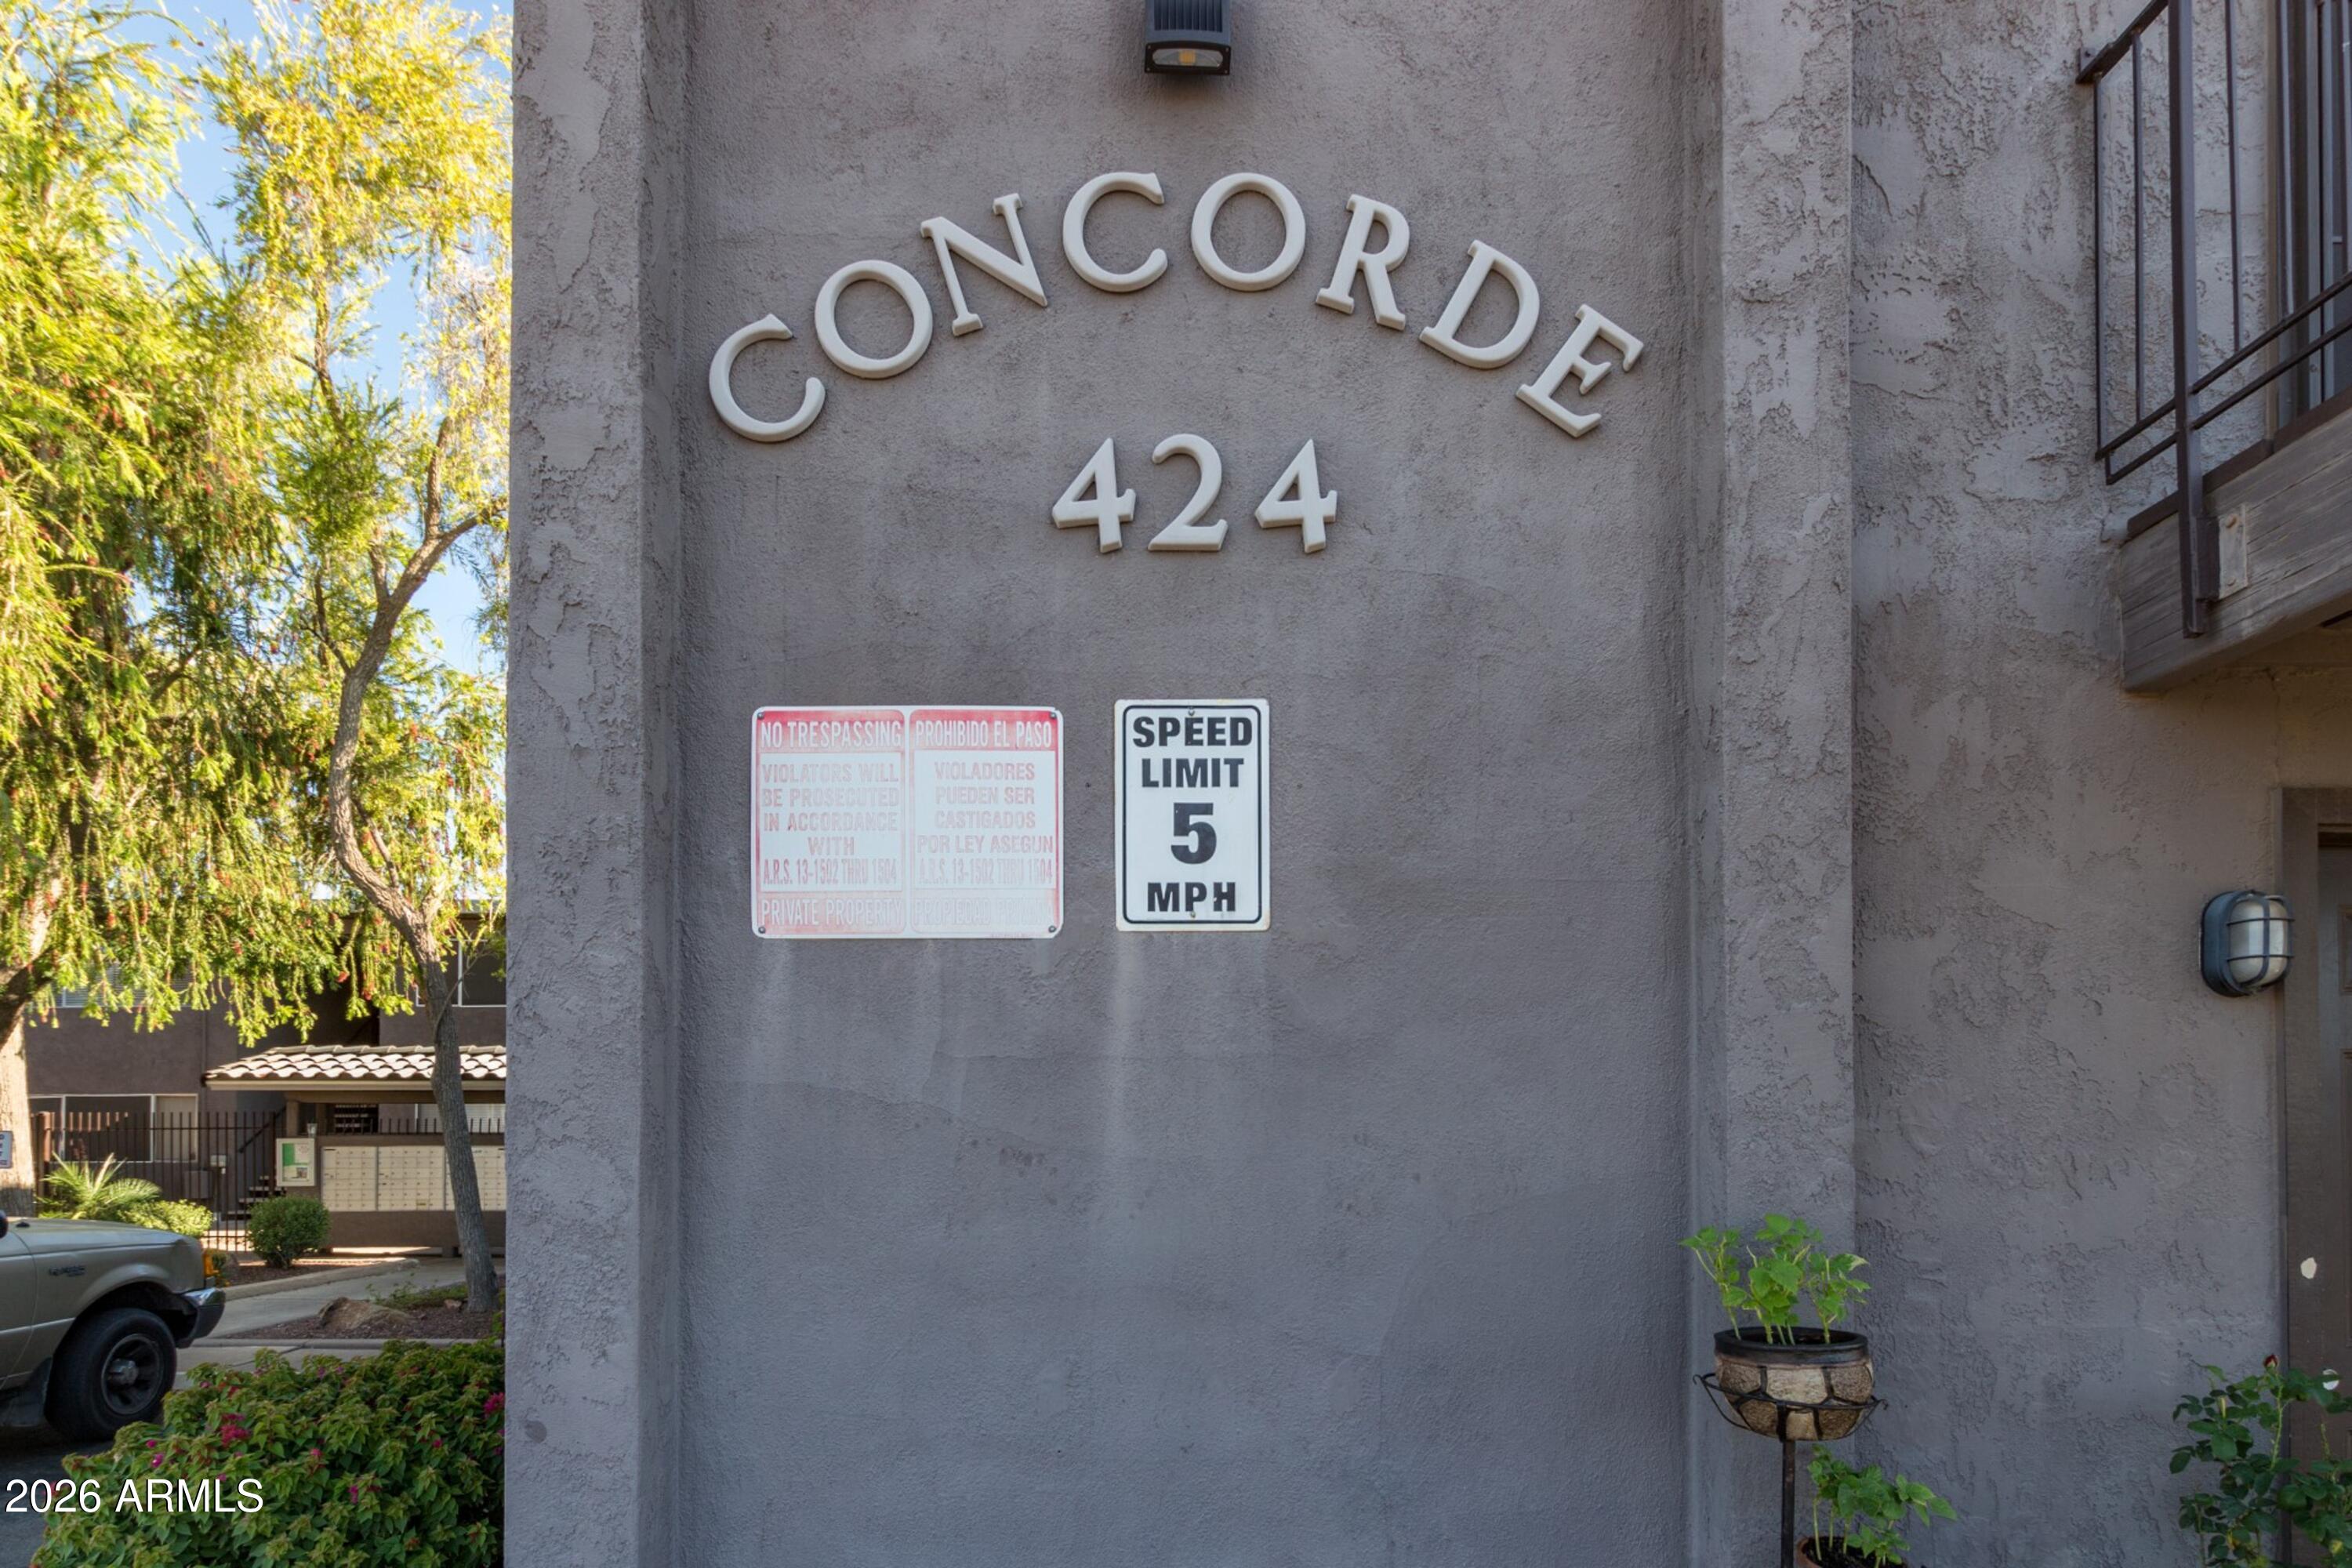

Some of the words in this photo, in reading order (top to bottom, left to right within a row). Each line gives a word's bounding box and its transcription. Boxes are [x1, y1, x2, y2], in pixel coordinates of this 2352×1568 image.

[709, 172, 1644, 443] CONCORDE
[1051, 433, 1338, 554] 424
[761, 721, 782, 748] NO
[787, 720, 903, 748] TRESPASSING
[915, 720, 989, 748] PROHIBIDO
[993, 721, 1010, 748] EL
[1015, 721, 1052, 748] PASO
[1132, 716, 1253, 747] SPEED
[762, 763, 852, 783] VIOLATORS
[858, 763, 899, 782] WILL
[934, 762, 1035, 781] VIOLADORES
[1142, 757, 1244, 788] LIMIT
[763, 789, 782, 807] BE
[789, 788, 899, 807] PROSECUTED
[935, 786, 999, 805] PUEDEN
[1004, 786, 1035, 804] SER
[764, 813, 779, 832] IN
[787, 812, 898, 832] ACCORDANCE
[935, 811, 1036, 829] CASTIGADOS
[1171, 802, 1217, 865] 5
[808, 837, 855, 856] WITH
[917, 835, 950, 854] POR
[955, 835, 985, 854] LEY
[990, 835, 1053, 854] ASEGUN
[763, 859, 793, 885] A.R.S.
[797, 859, 839, 885] 13-1502
[841, 859, 869, 885] THRU
[1147, 882, 1236, 913] MPH
[761, 899, 819, 926] PRIVATE
[826, 898, 903, 926] PROPERTY
